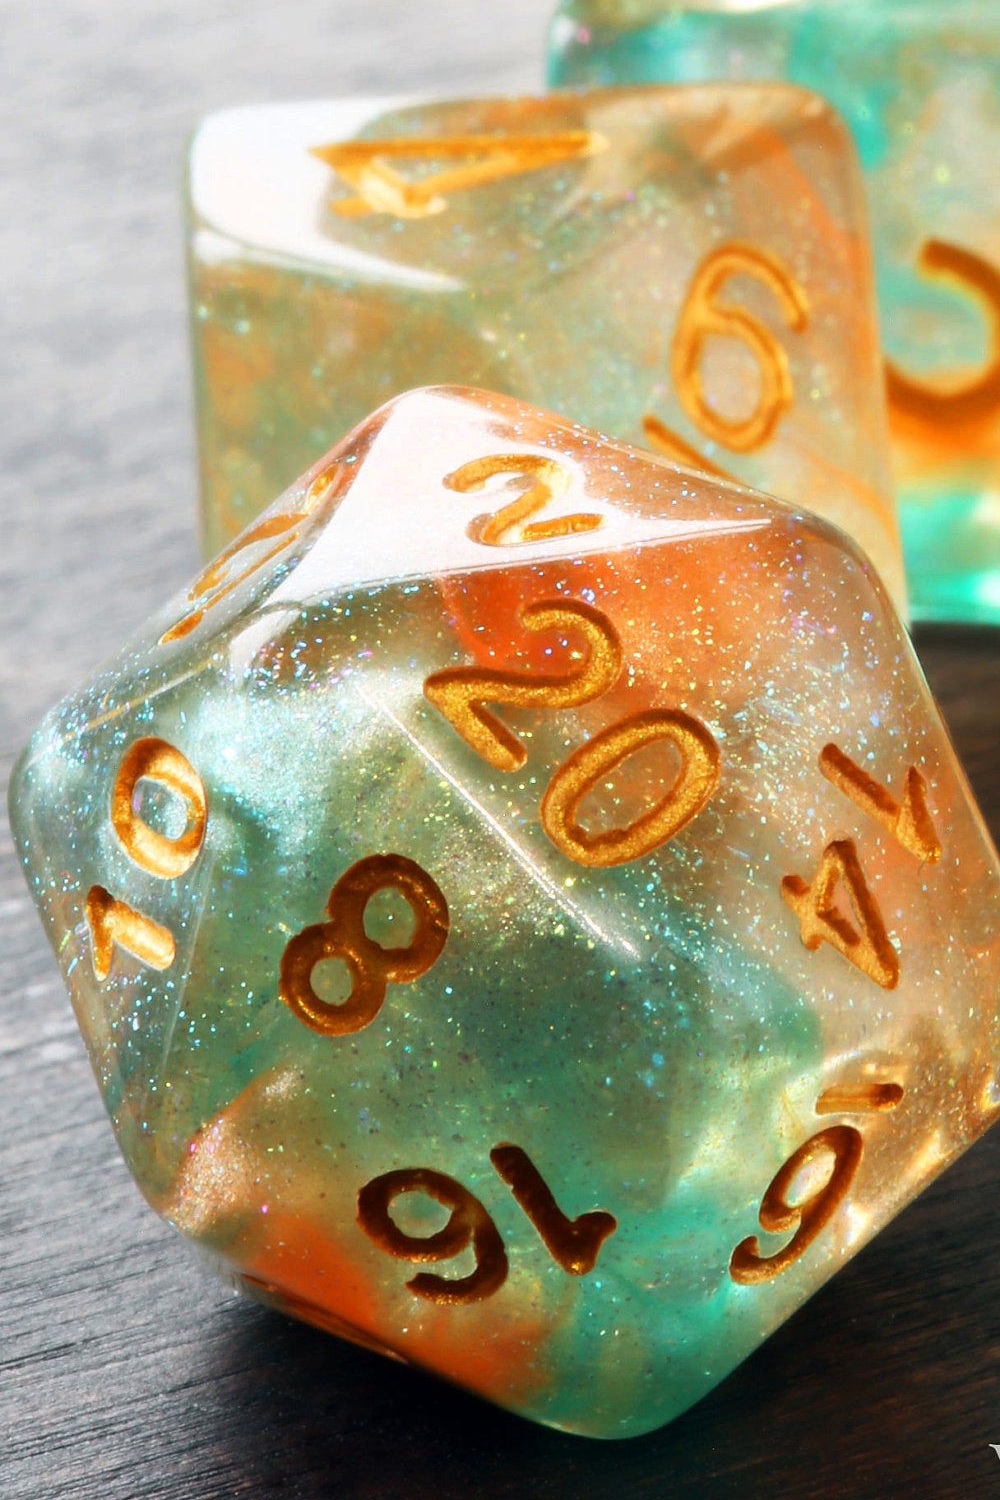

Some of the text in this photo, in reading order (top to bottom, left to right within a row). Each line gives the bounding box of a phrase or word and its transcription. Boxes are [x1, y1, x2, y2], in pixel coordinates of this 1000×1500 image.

[443, 453, 605, 548] 2
[424, 599, 722, 868] 20
[86, 737, 208, 982] 10
[280, 853, 450, 1036] 8
[781, 743, 942, 990] 14
